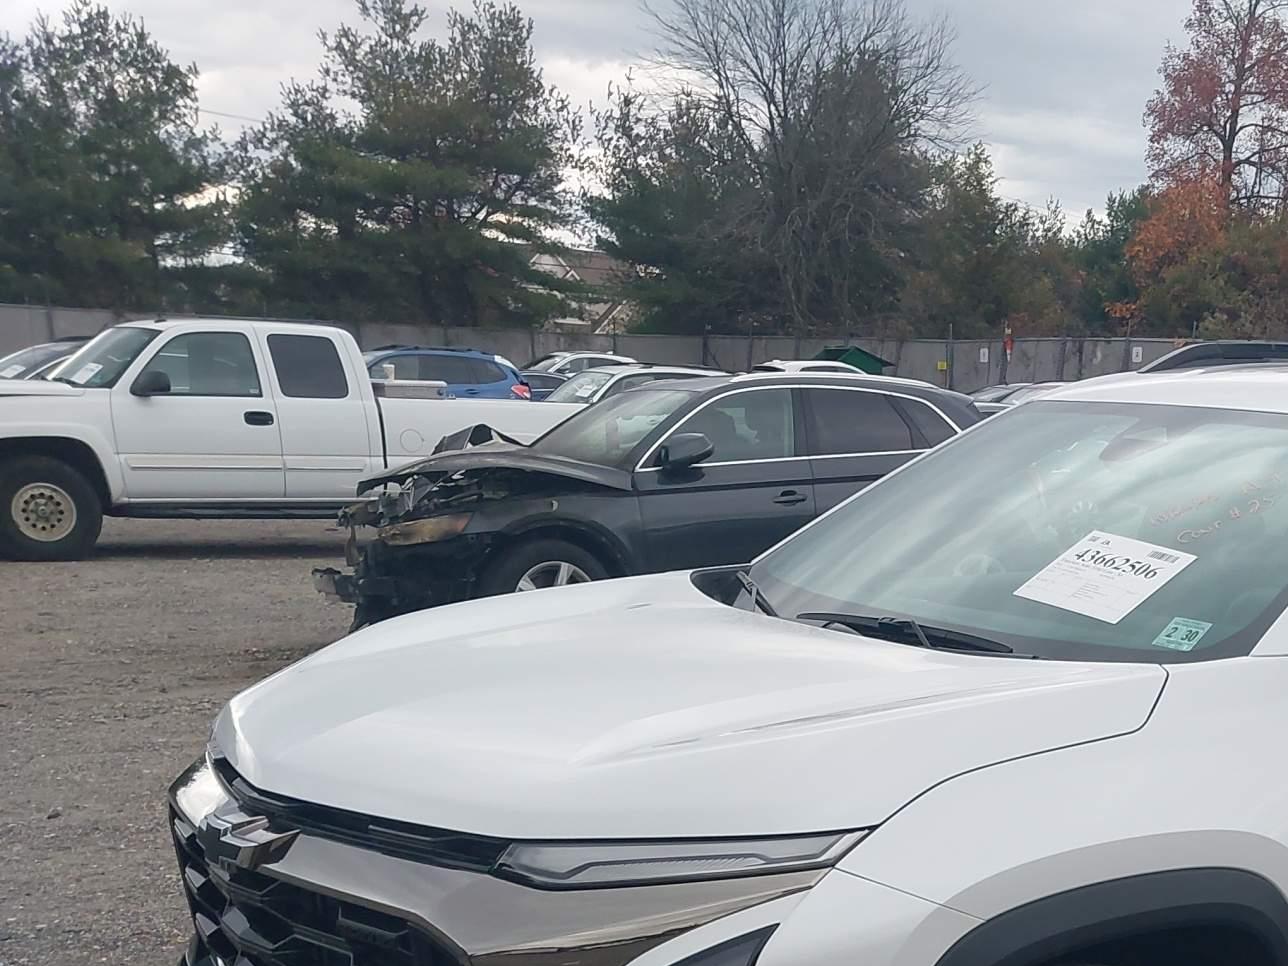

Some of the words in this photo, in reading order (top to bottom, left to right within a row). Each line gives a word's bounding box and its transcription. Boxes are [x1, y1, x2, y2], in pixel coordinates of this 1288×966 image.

[1074, 548, 1164, 580] 43662506
[1164, 626, 1179, 638] 2
[1180, 629, 1200, 642] 30
